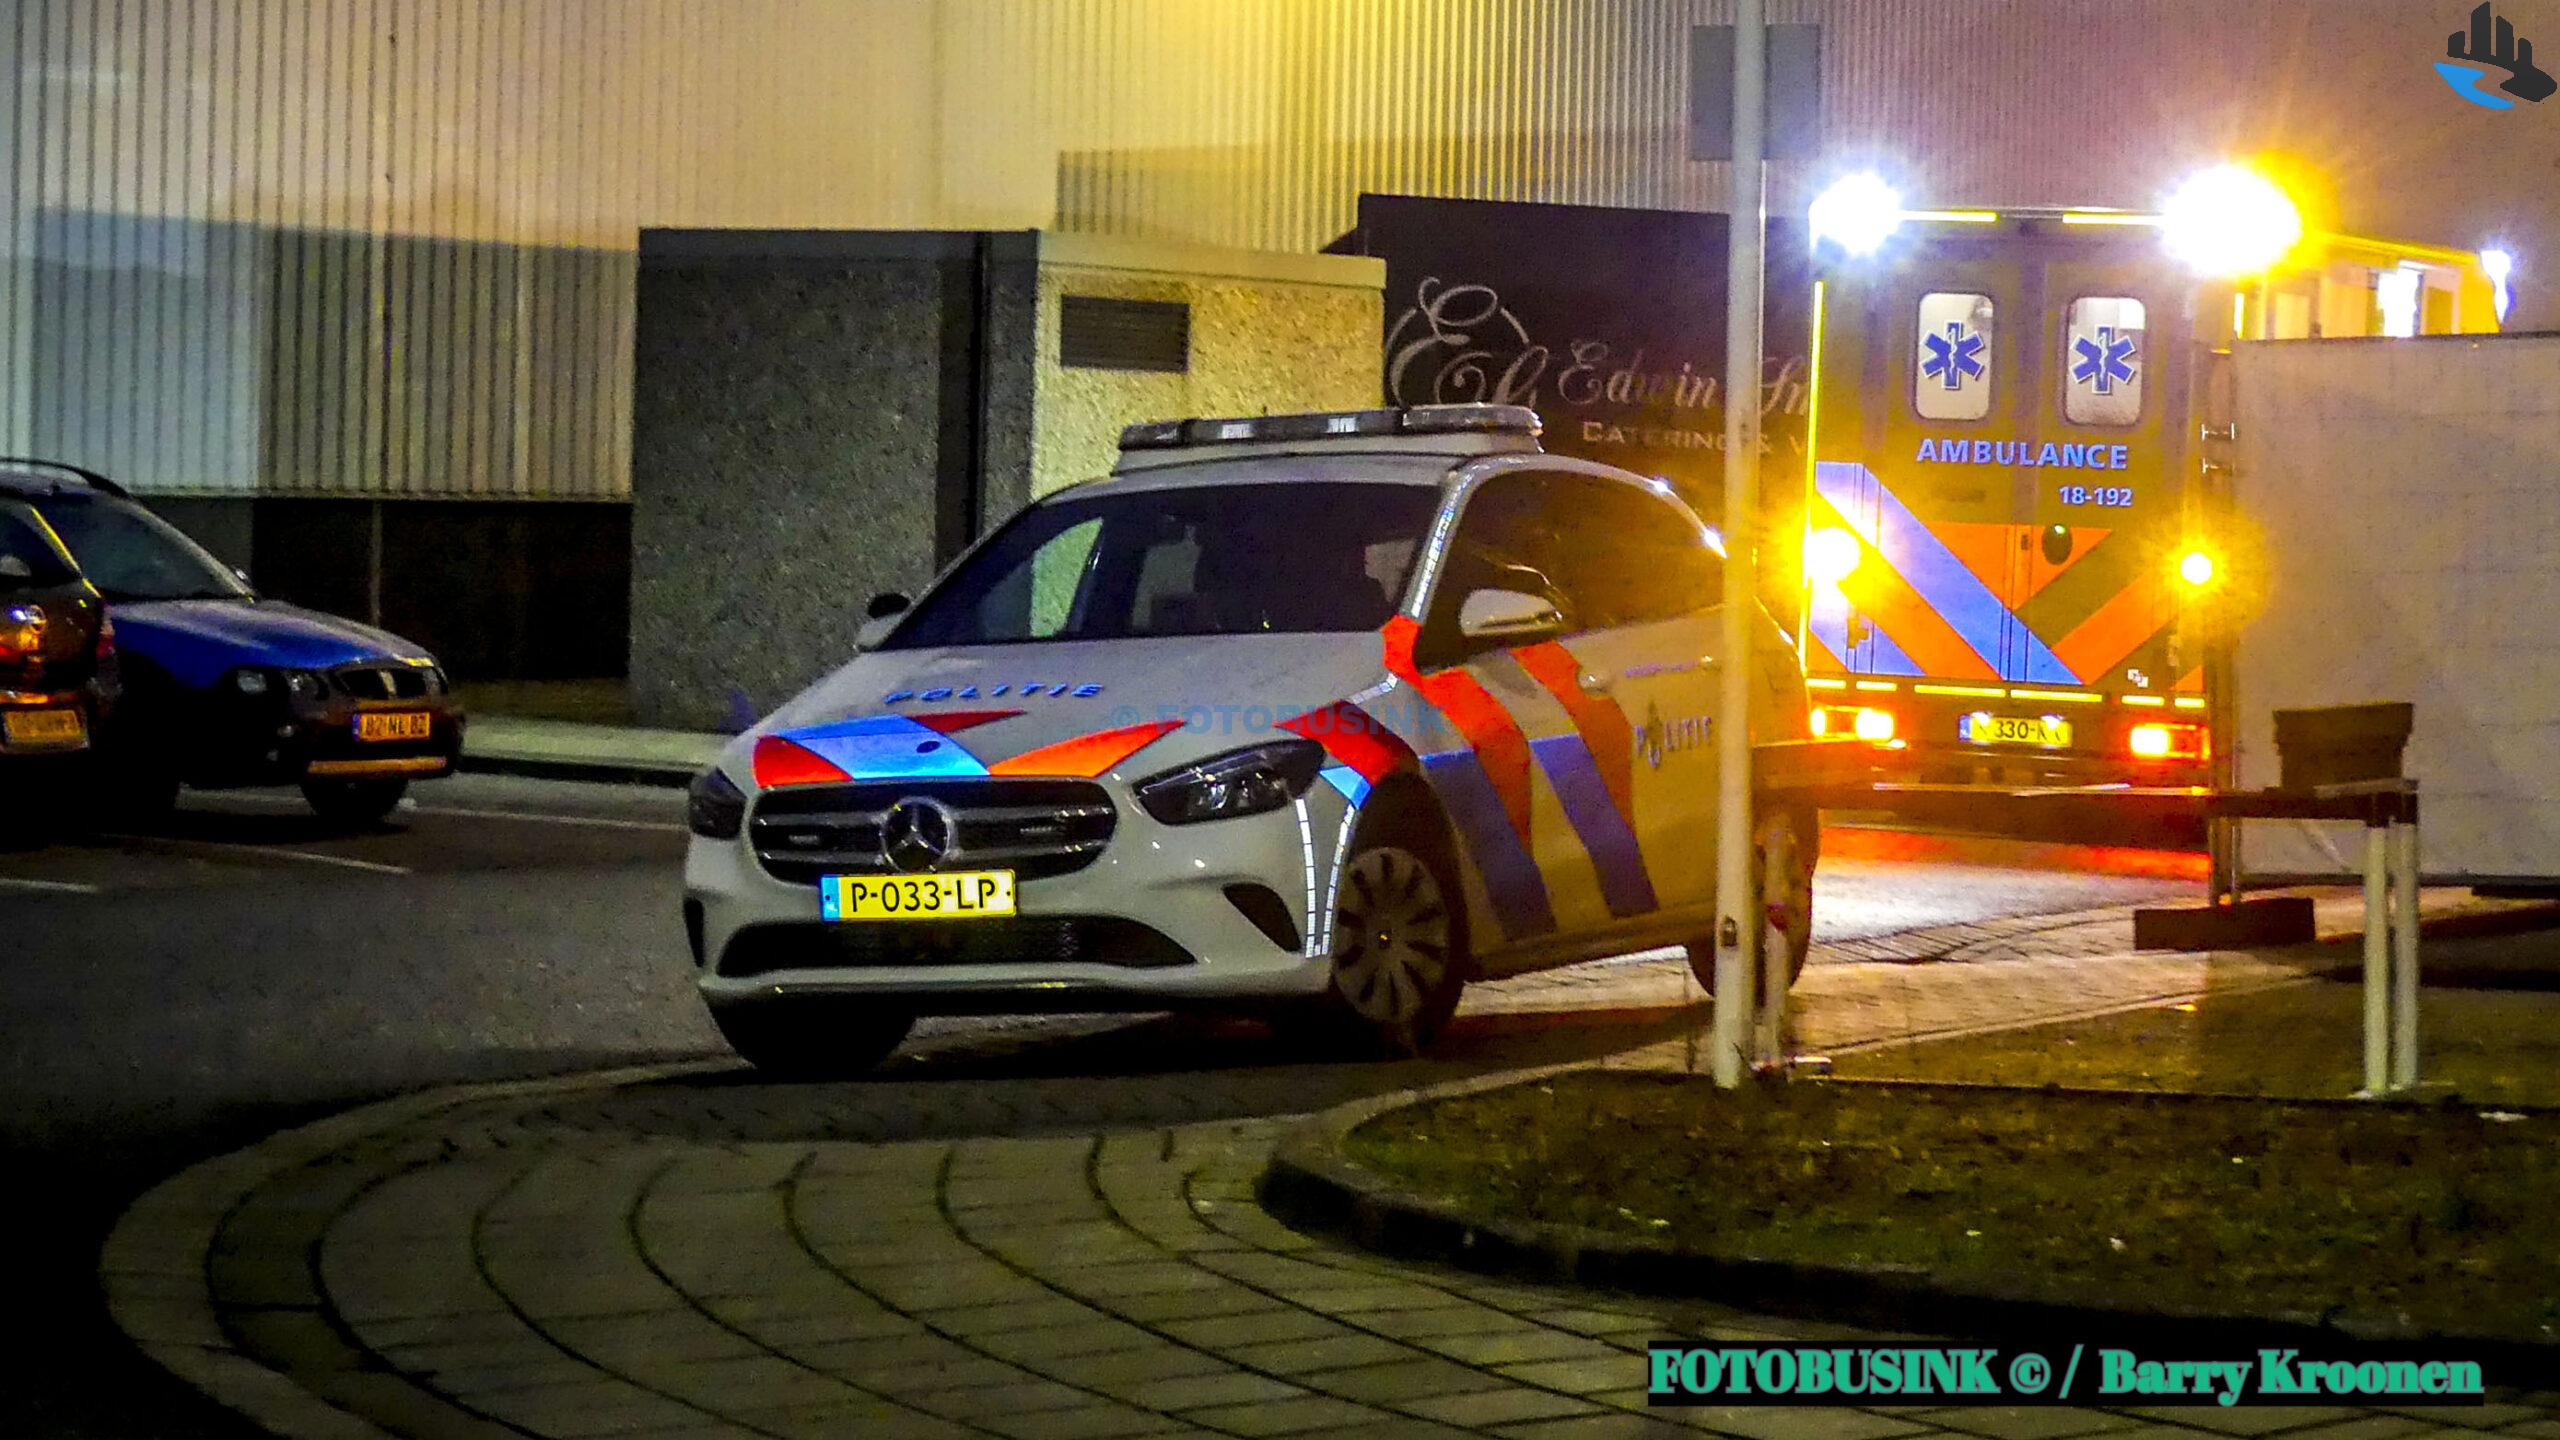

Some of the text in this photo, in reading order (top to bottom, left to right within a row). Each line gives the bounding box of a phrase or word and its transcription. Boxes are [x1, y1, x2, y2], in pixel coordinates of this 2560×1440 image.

[1916, 438, 2129, 470] AMBULANCE
[2059, 486, 2133, 507] 18-192
[884, 683, 1104, 705] POLITIE
[851, 878, 996, 912] P-033-LP
